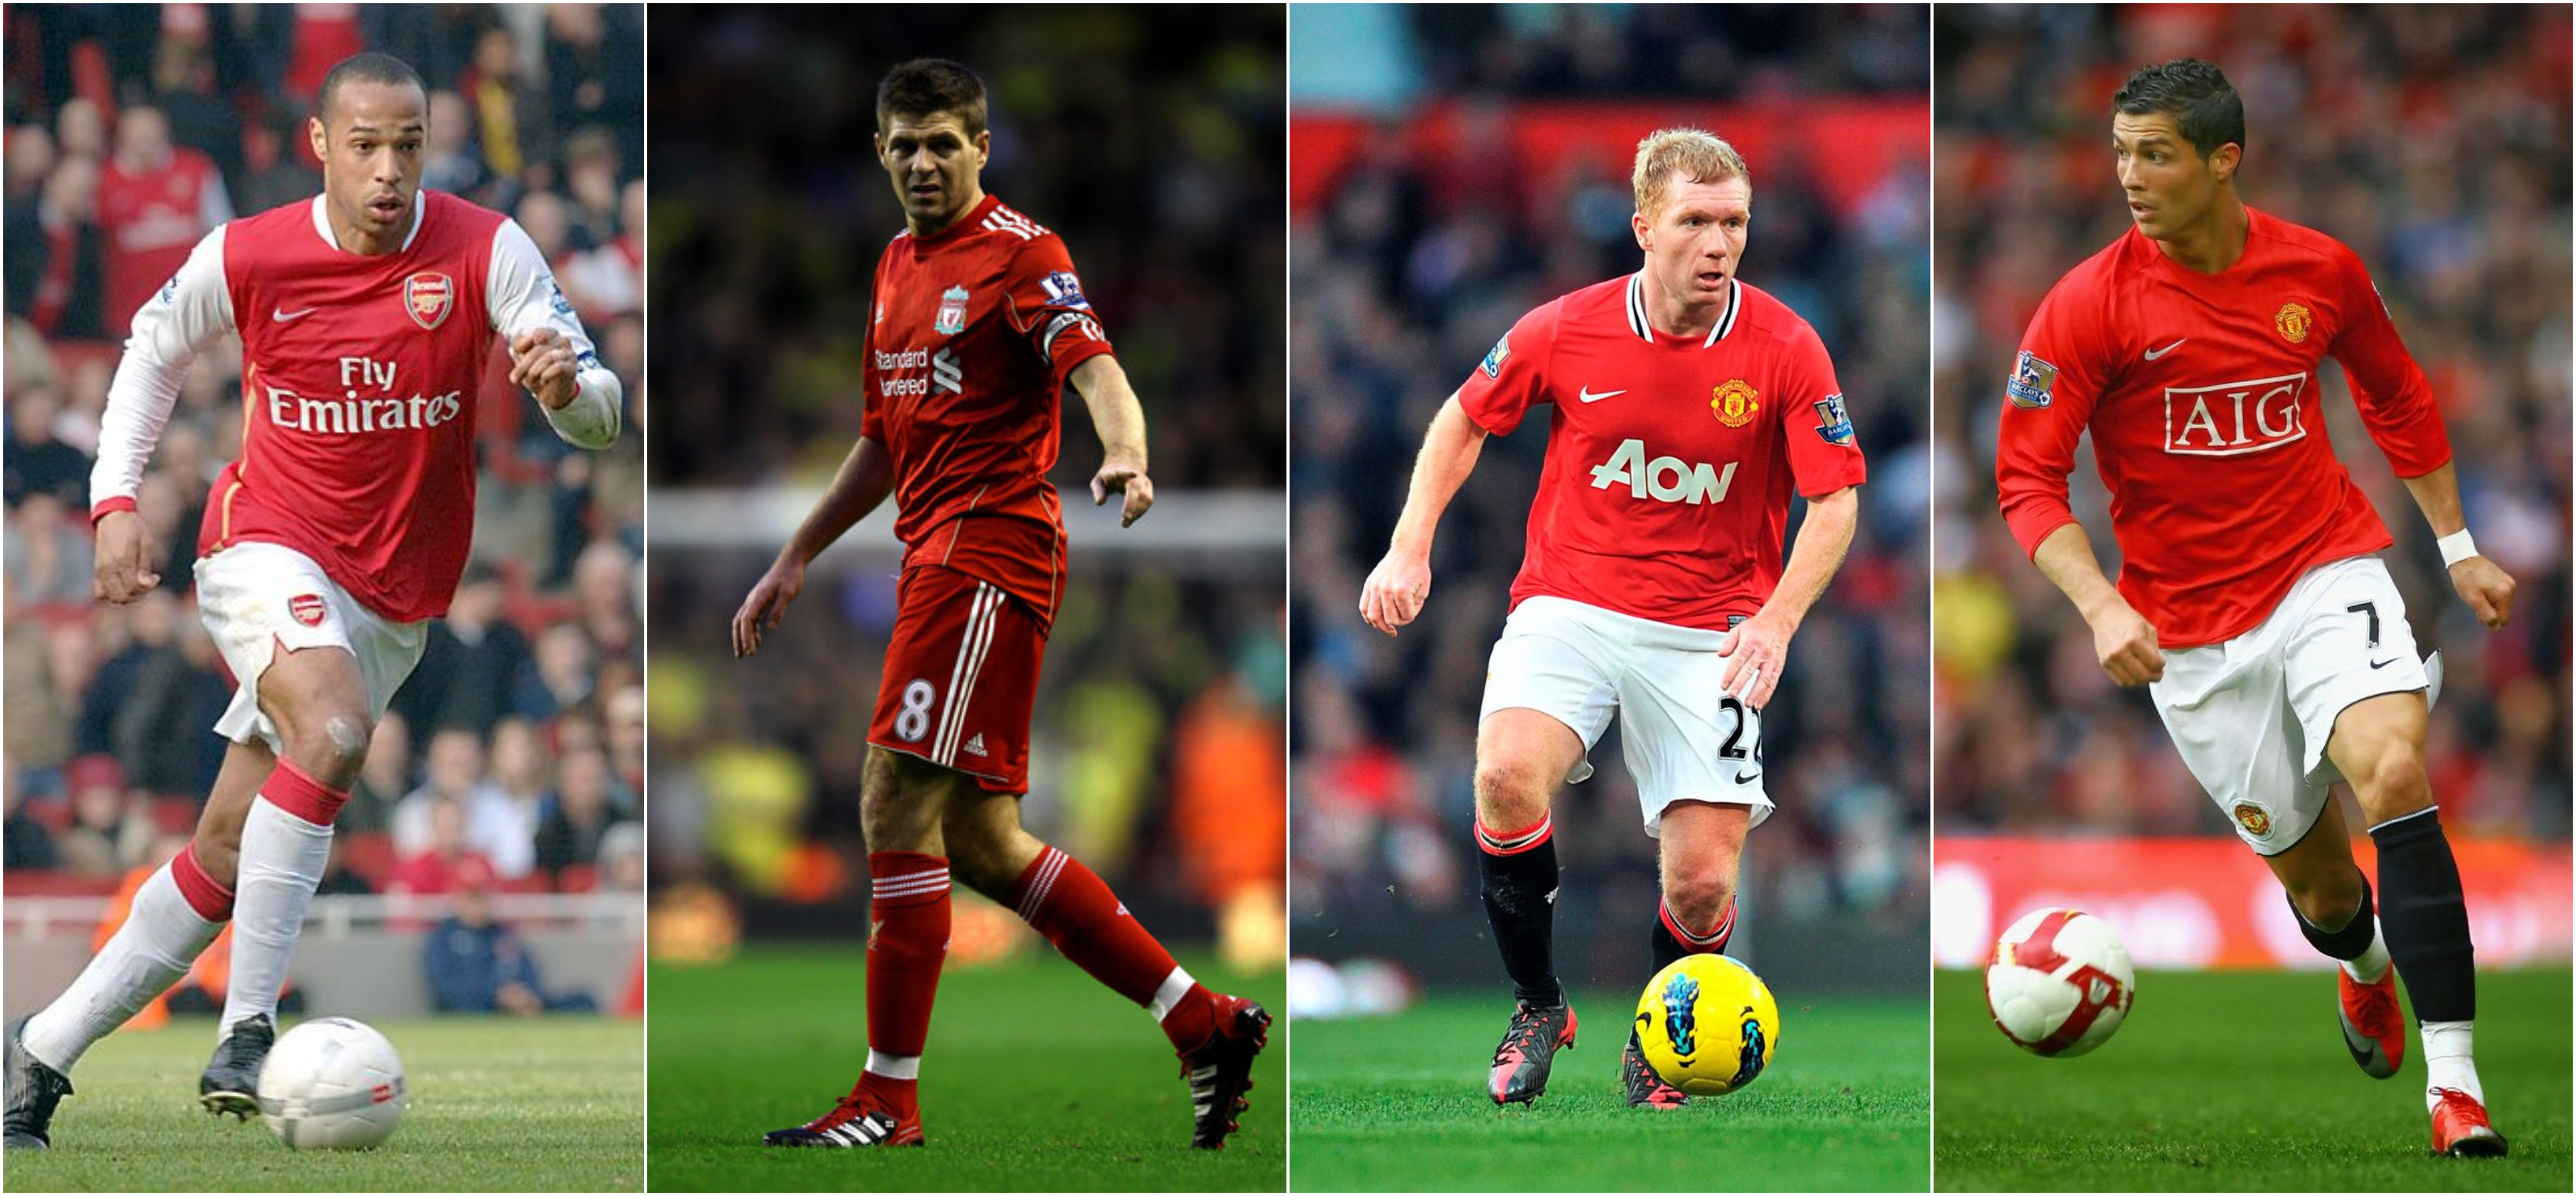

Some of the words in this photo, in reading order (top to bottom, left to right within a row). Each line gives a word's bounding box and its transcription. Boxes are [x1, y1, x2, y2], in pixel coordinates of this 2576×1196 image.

[340, 357, 396, 392] Fly
[1717, 381, 1755, 399] MANCHESTER
[267, 385, 461, 433] Emirates
[1720, 414, 1748, 425] UNITED
[2174, 384, 2295, 446] AIG
[2346, 600, 2382, 650] 7
[893, 677, 936, 742] 8
